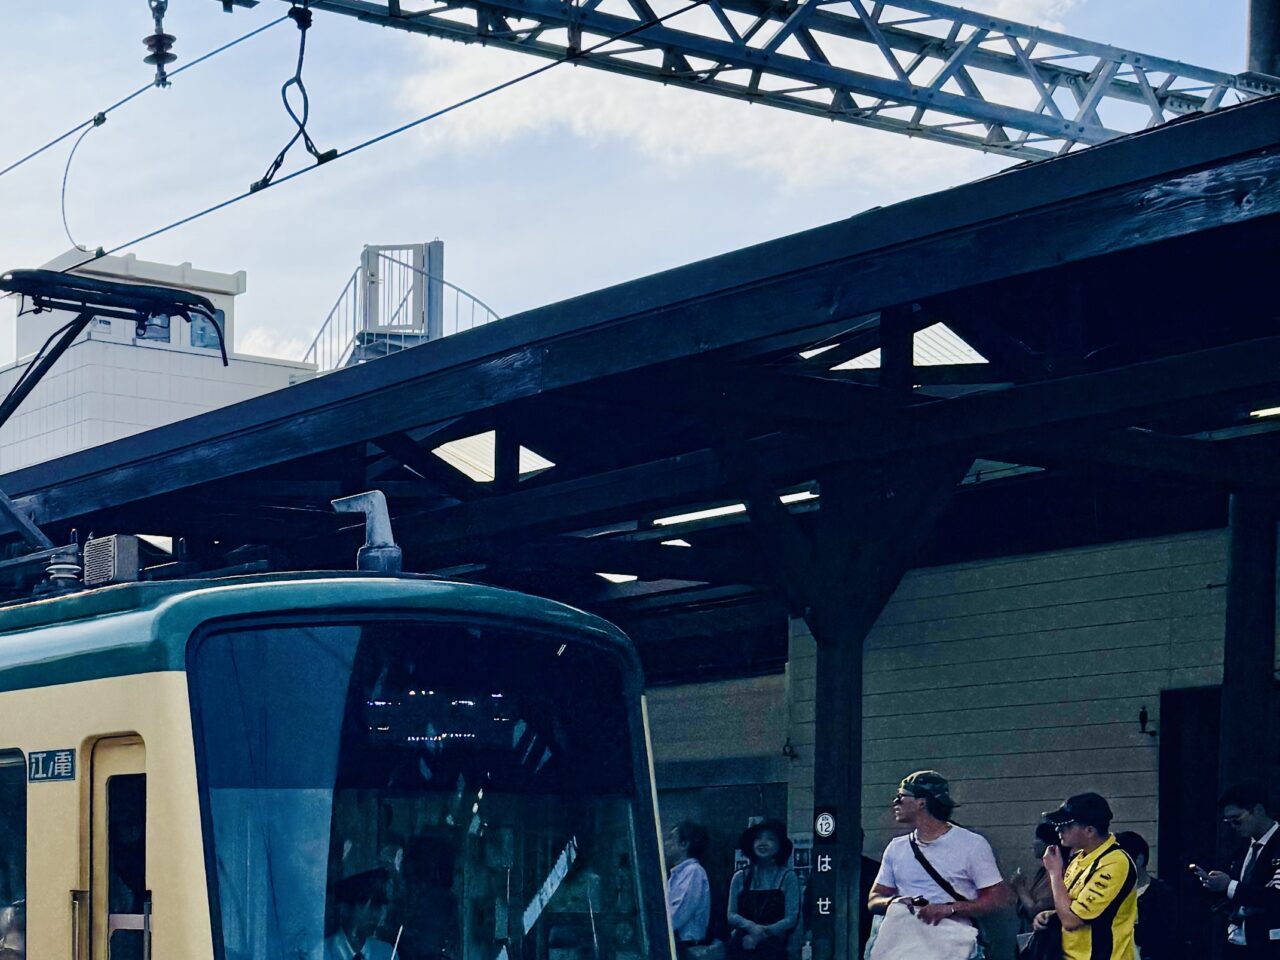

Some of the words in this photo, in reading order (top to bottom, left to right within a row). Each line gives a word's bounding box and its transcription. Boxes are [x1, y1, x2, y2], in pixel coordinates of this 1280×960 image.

[30, 751, 71, 779] 江ノ電
[819, 822, 831, 832] 12
